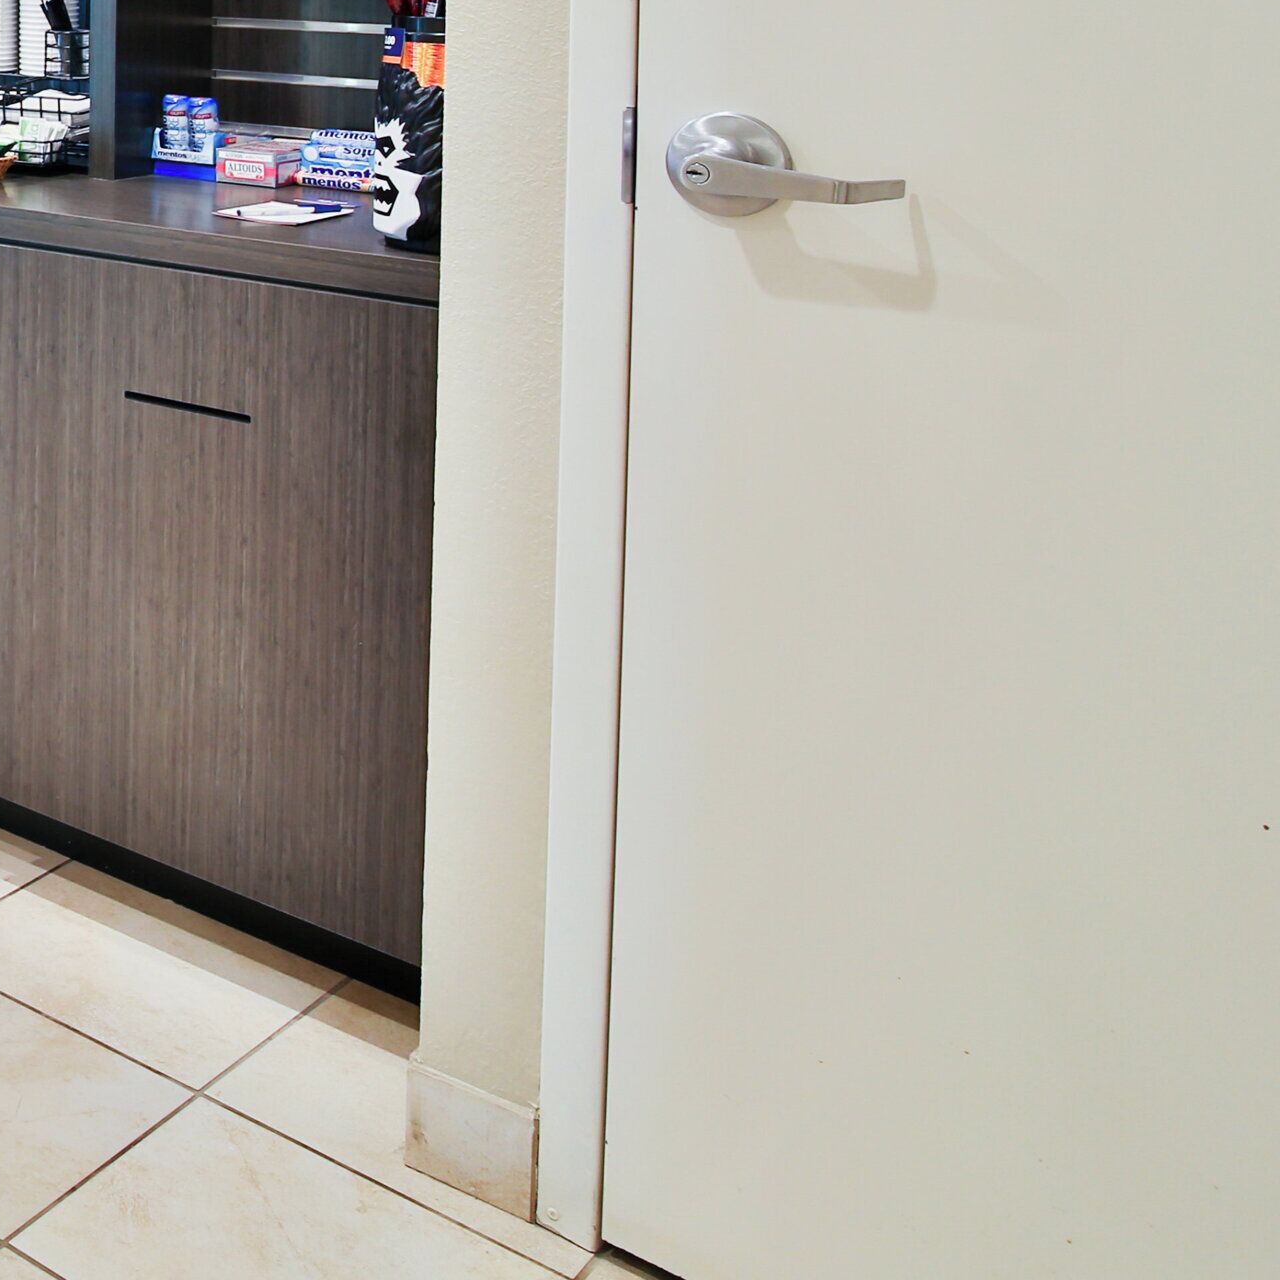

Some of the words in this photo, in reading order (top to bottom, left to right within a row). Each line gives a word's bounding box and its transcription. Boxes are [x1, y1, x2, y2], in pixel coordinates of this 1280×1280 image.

[158, 150, 187, 159] mentos
[228, 162, 263, 174] ALTOIDS
[302, 177, 362, 190] mentos
